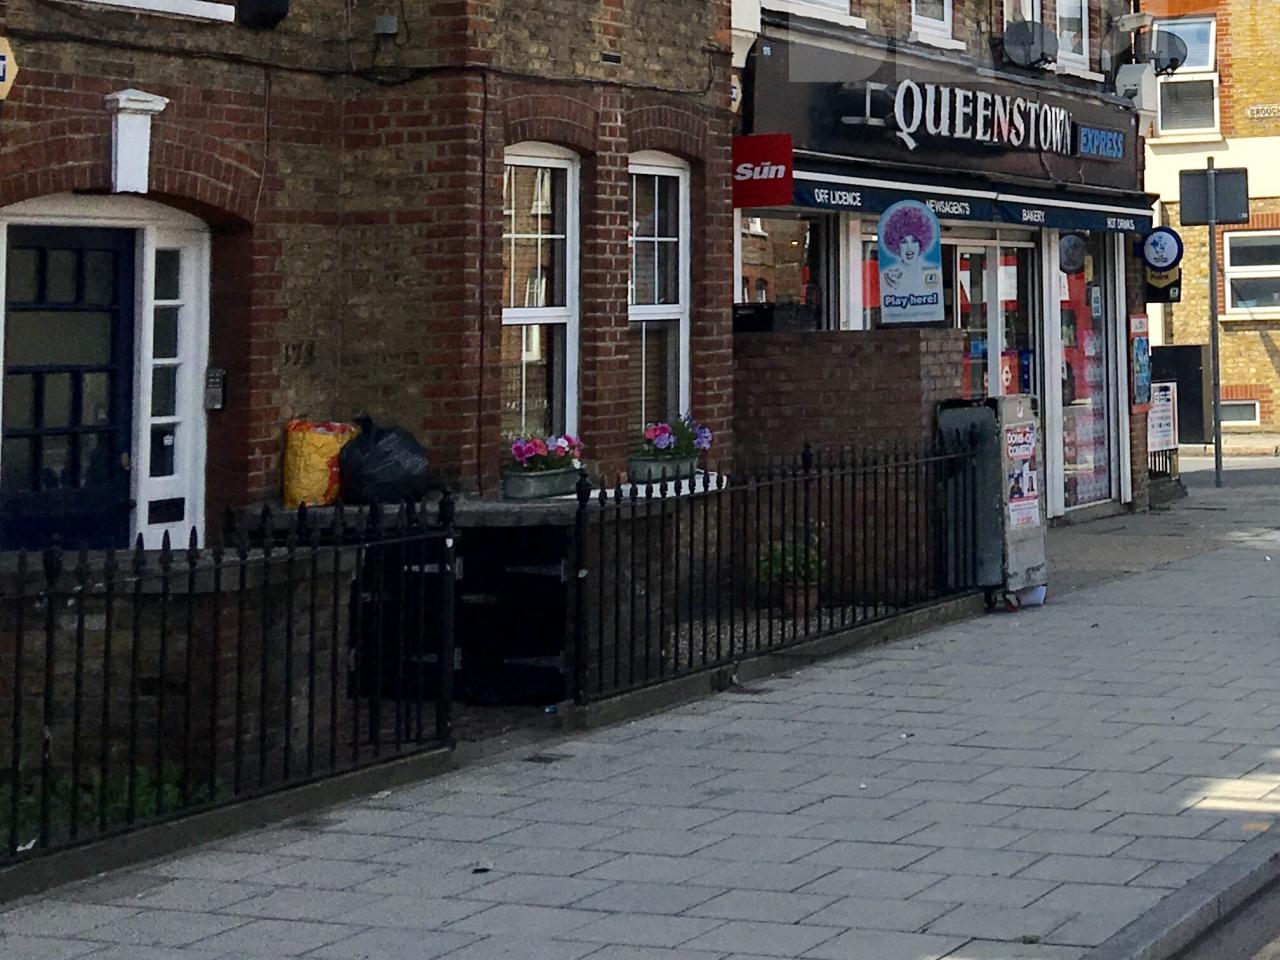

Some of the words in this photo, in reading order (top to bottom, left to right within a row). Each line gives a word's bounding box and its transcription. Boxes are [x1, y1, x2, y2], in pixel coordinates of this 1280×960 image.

[894, 79, 1072, 155] QUEENSTOWN
[1079, 126, 1124, 159] EXPRESS
[734, 162, 786, 181] Sun
[814, 188, 829, 204] OFF
[830, 189, 862, 207] LICENCE
[925, 199, 971, 215] NEWSAGENTS
[1022, 208, 1045, 223] BAKERY
[1106, 217, 1116, 229] HOT
[884, 294, 908, 309] Play
[909, 292, 938, 306] here!
